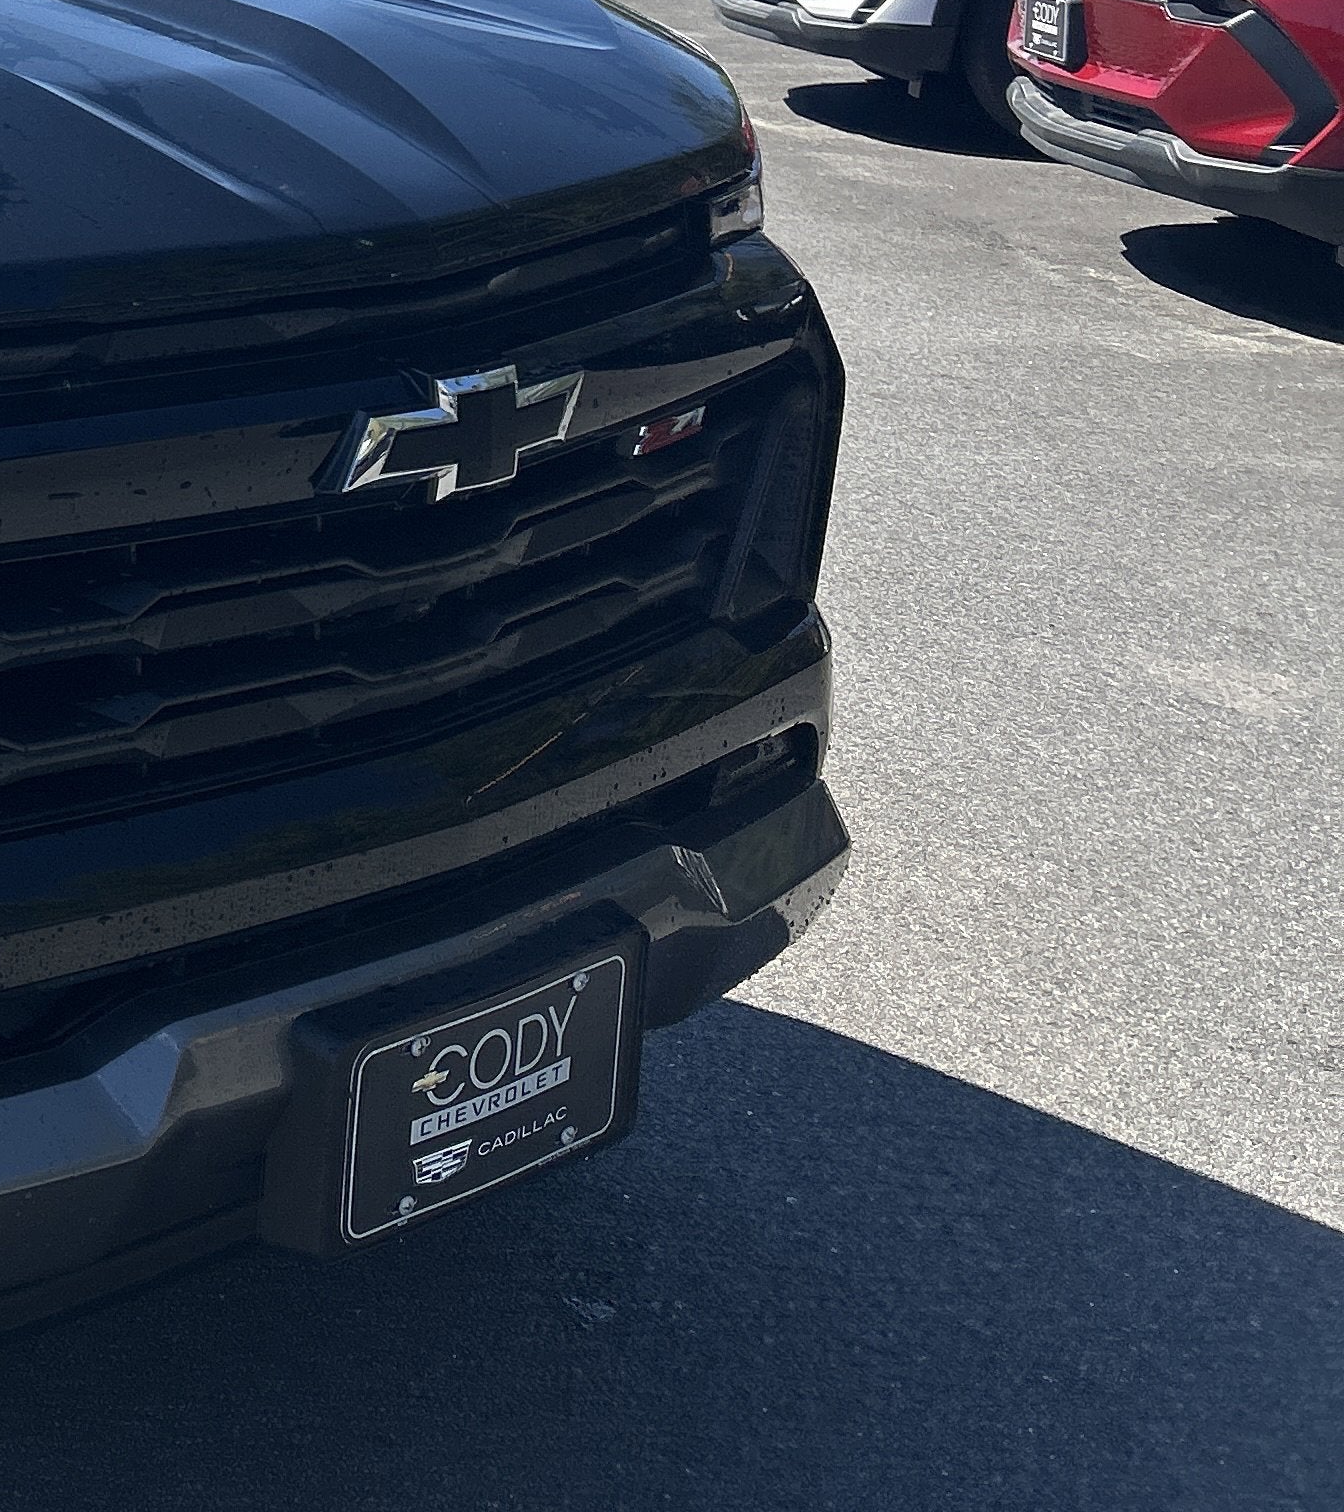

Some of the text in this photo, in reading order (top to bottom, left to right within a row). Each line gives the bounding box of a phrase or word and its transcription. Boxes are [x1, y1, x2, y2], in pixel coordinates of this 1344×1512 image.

[1033, 1, 1060, 25] CODY
[426, 995, 577, 1107] CODY
[419, 1064, 564, 1138] CHEVROLET
[477, 1106, 568, 1157] CADILLAC
